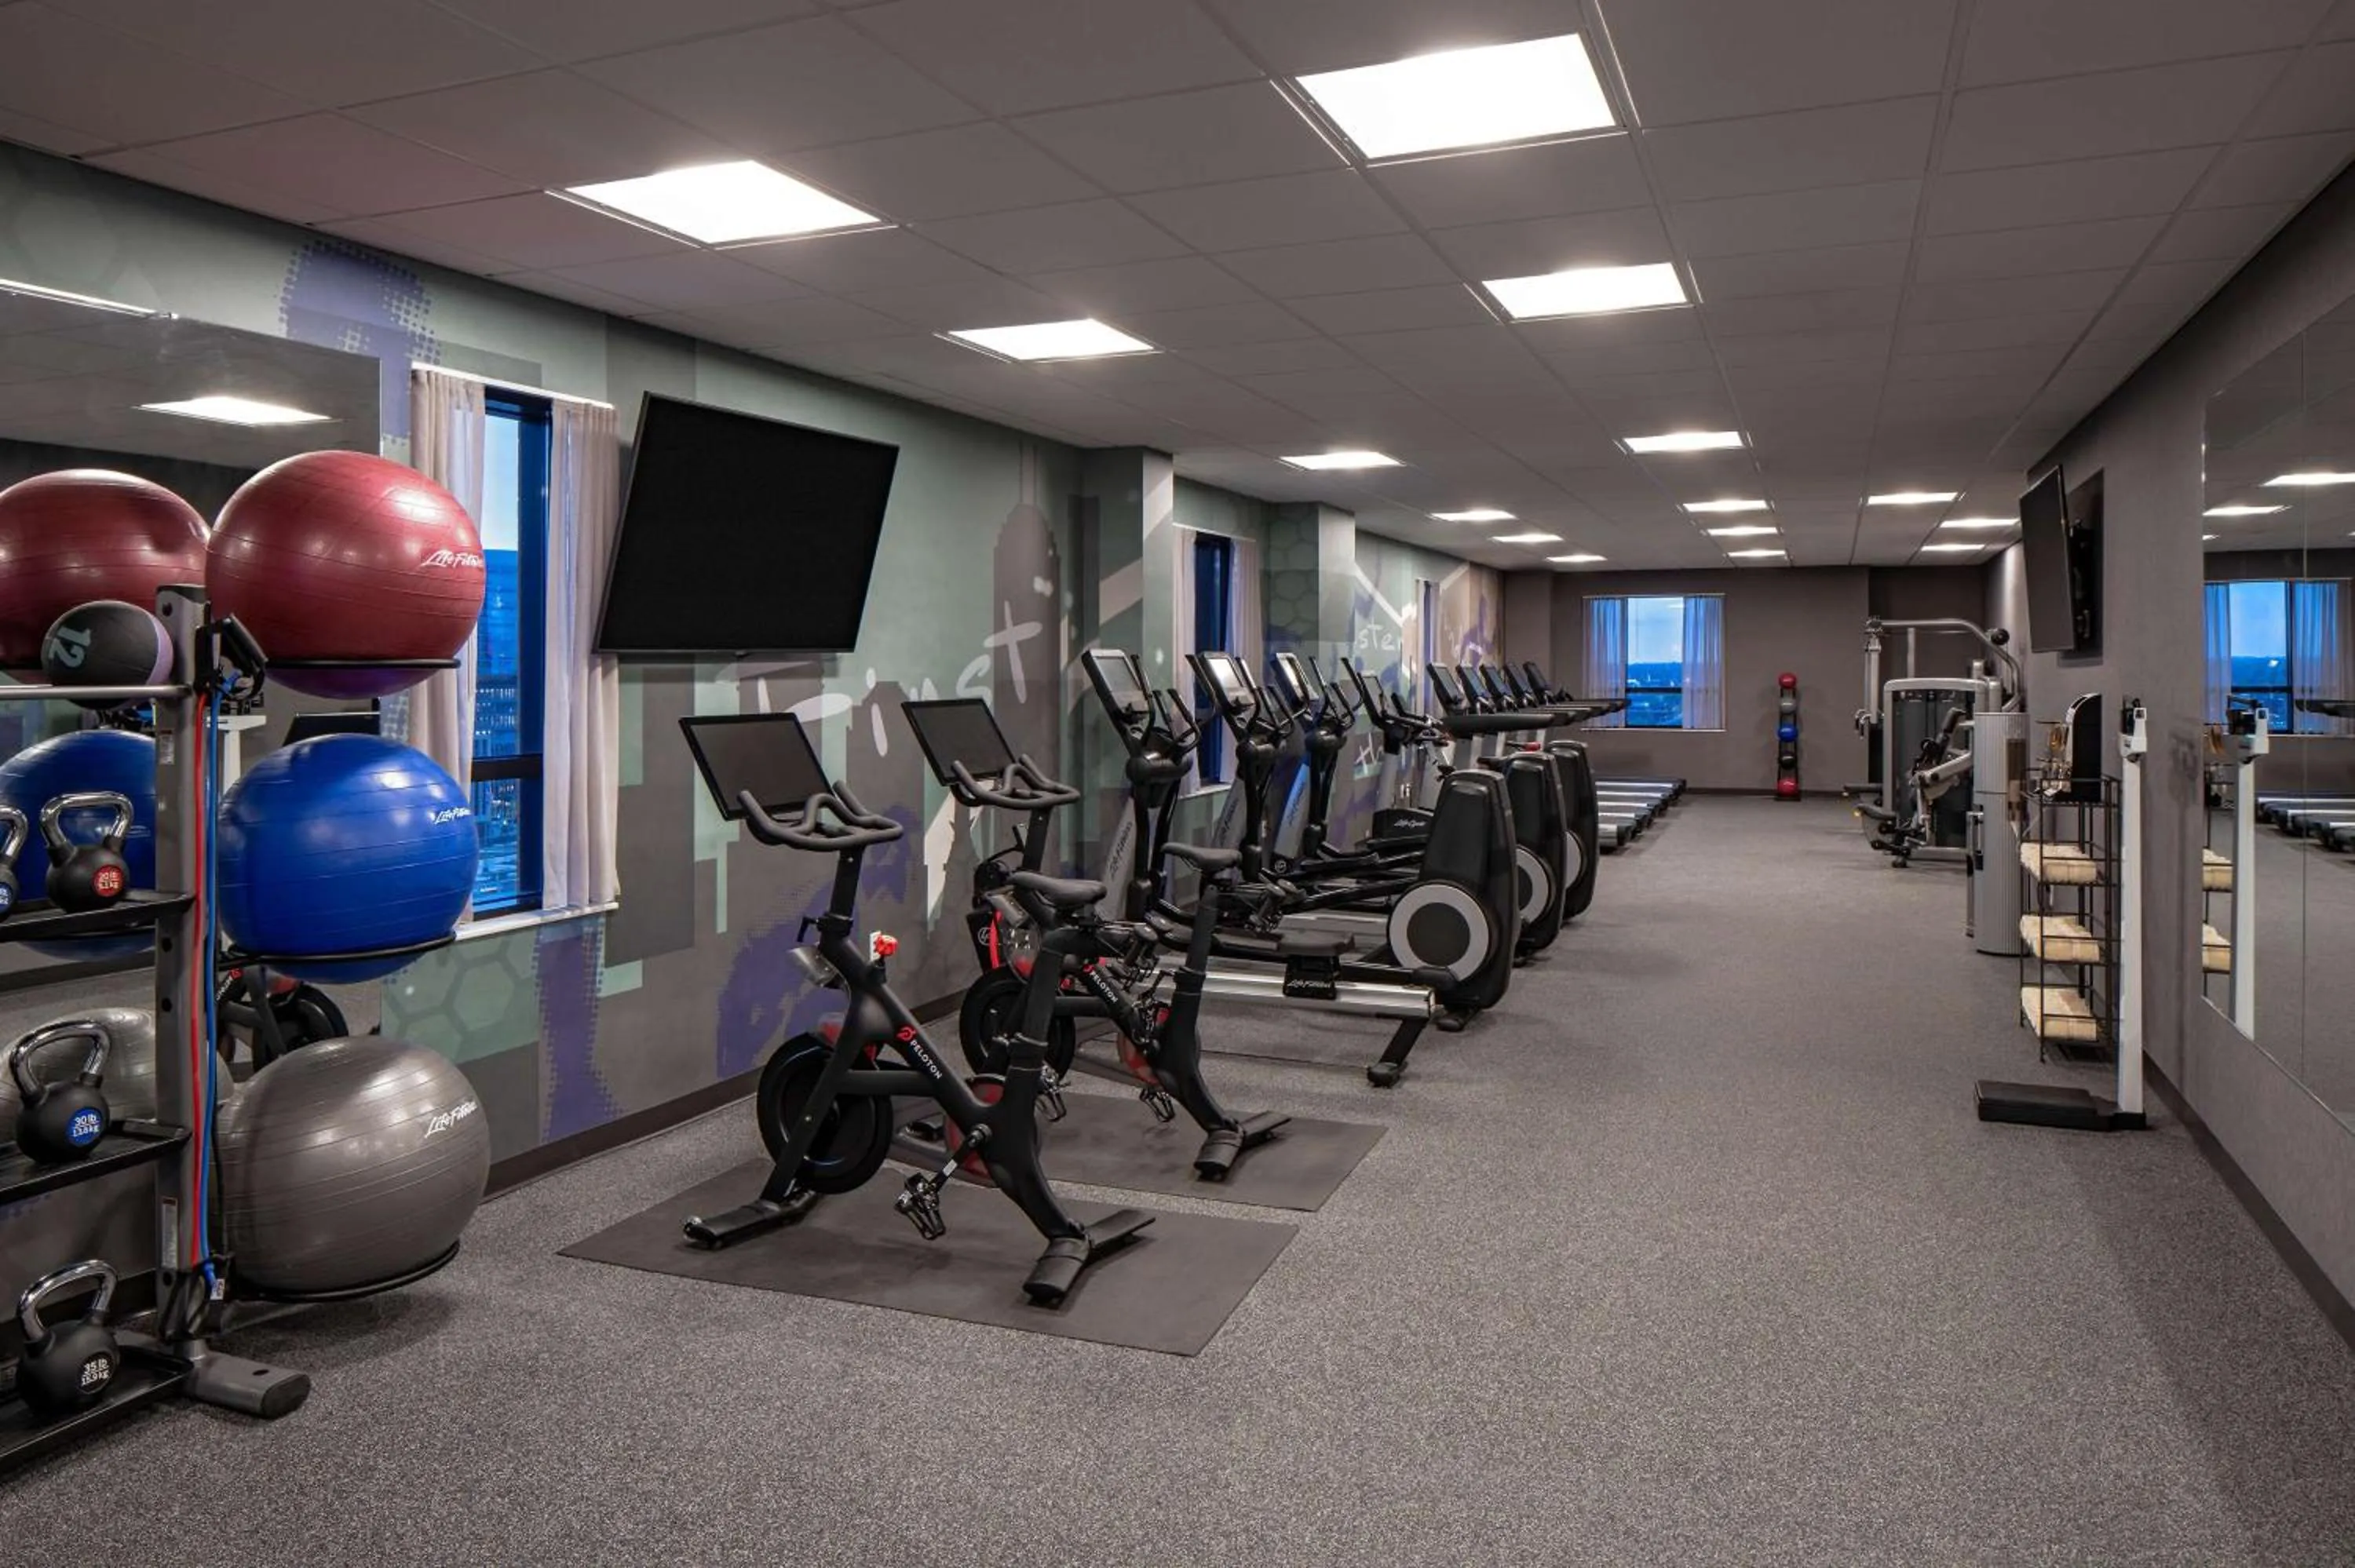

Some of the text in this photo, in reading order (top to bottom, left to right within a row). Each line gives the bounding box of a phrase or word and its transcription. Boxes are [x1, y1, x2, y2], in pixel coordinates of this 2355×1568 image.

[48, 626, 91, 667] 12
[1089, 970, 1119, 1003] PELOTON
[911, 1040, 943, 1079] PELOTON
[424, 1112, 451, 1139] Life
